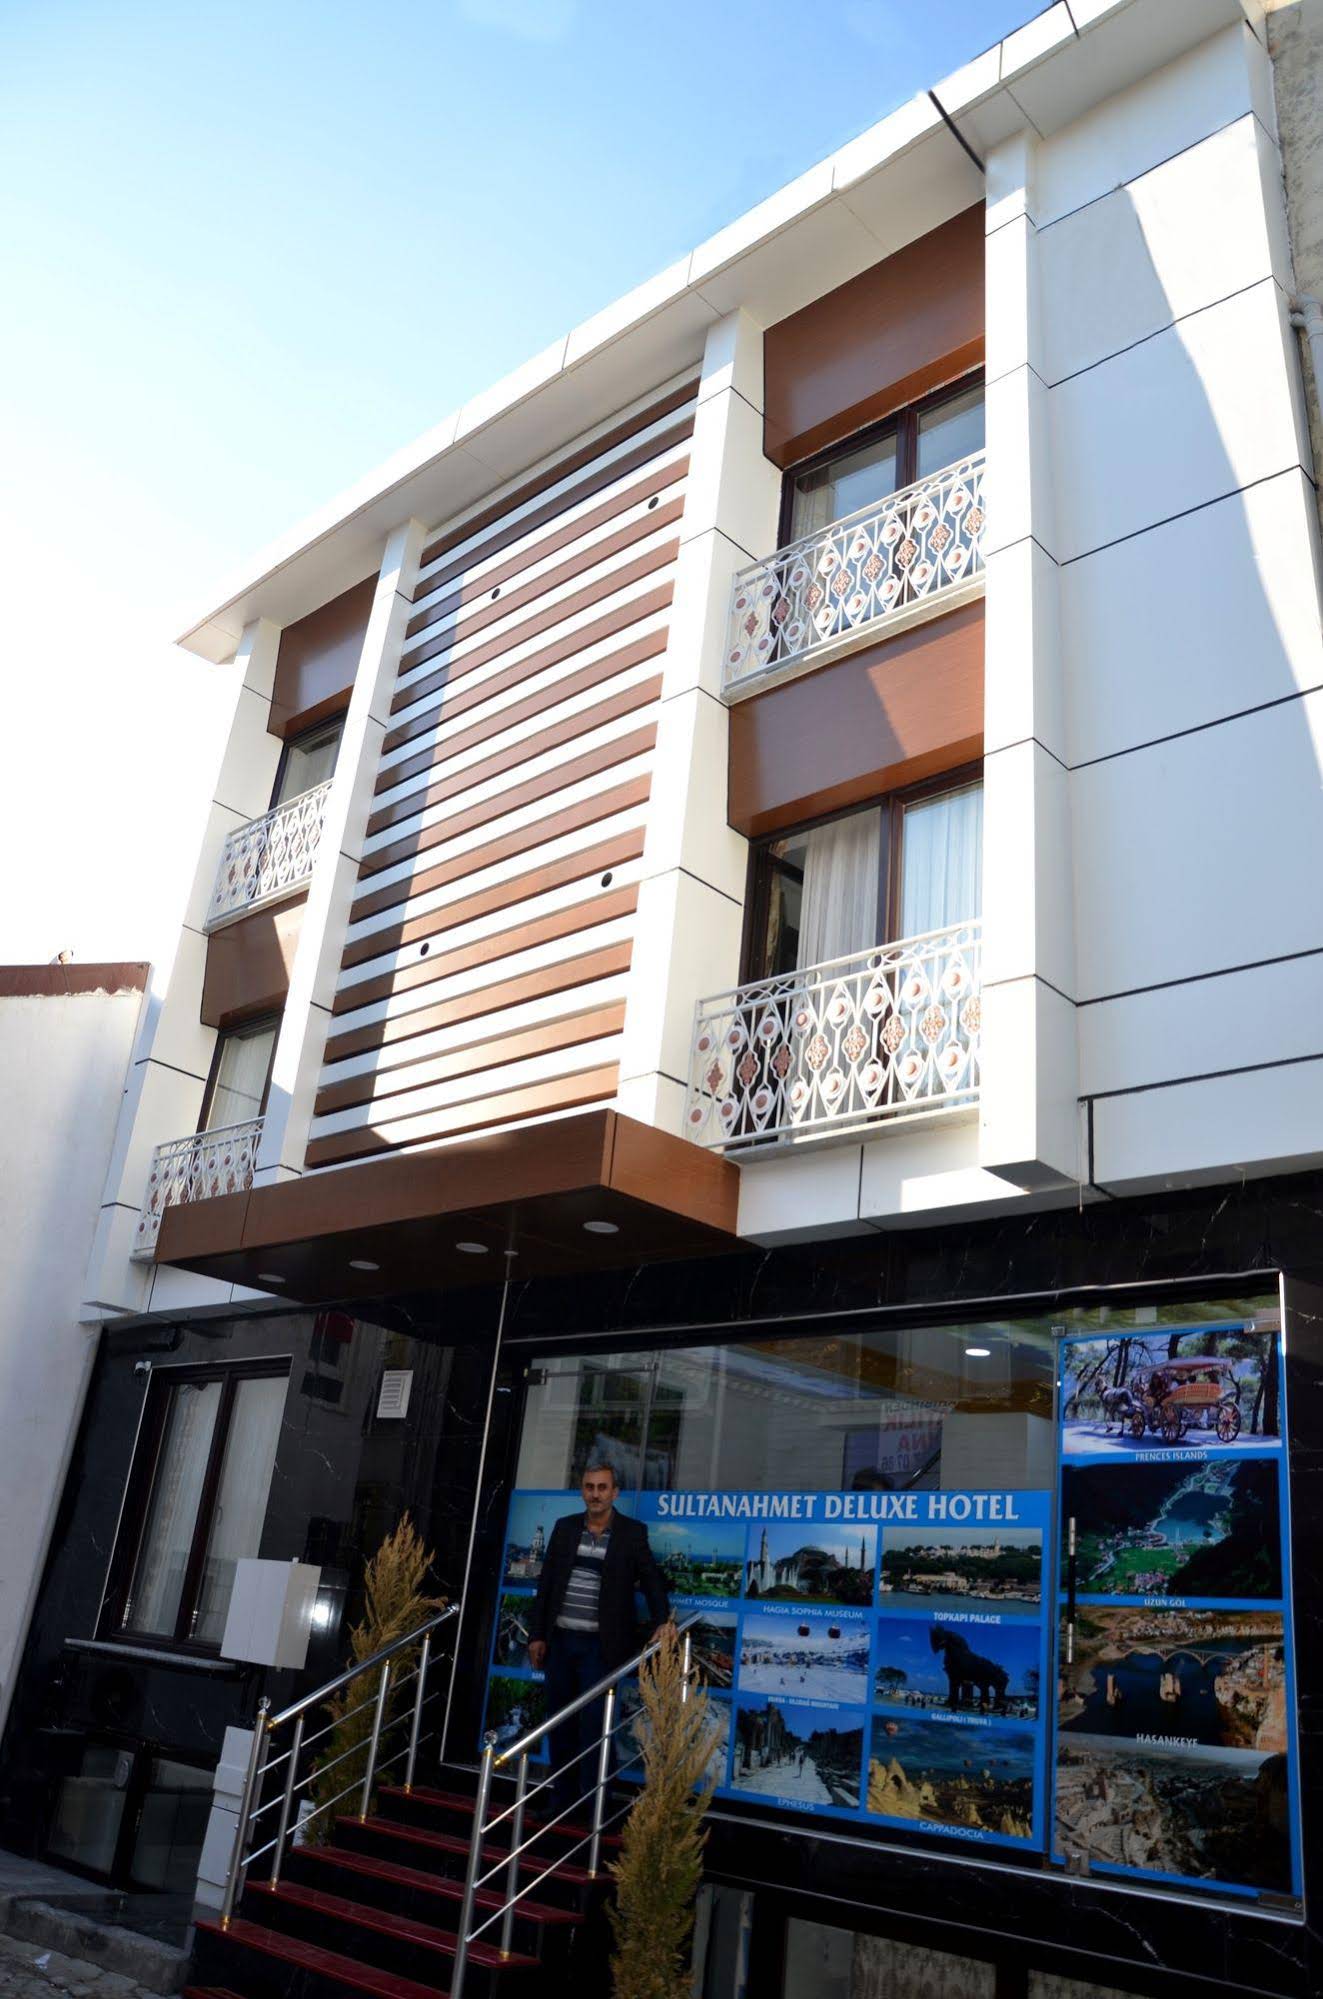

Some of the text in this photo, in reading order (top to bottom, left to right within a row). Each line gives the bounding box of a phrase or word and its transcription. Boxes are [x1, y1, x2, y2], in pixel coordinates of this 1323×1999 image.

[1172, 1450, 1208, 1460] ISLANDS
[656, 1494, 1019, 1520] SULTANAHMET DELUXE HOTEL
[694, 1598, 728, 1608] MOSQUE
[763, 1605, 863, 1619] HAGIA SOPHIA MUSEUM
[933, 1611, 1001, 1625] TOPKAPI PALACE
[1136, 1733, 1198, 1748] HASANKEYE
[919, 1821, 984, 1840] CAPPADOCIA
